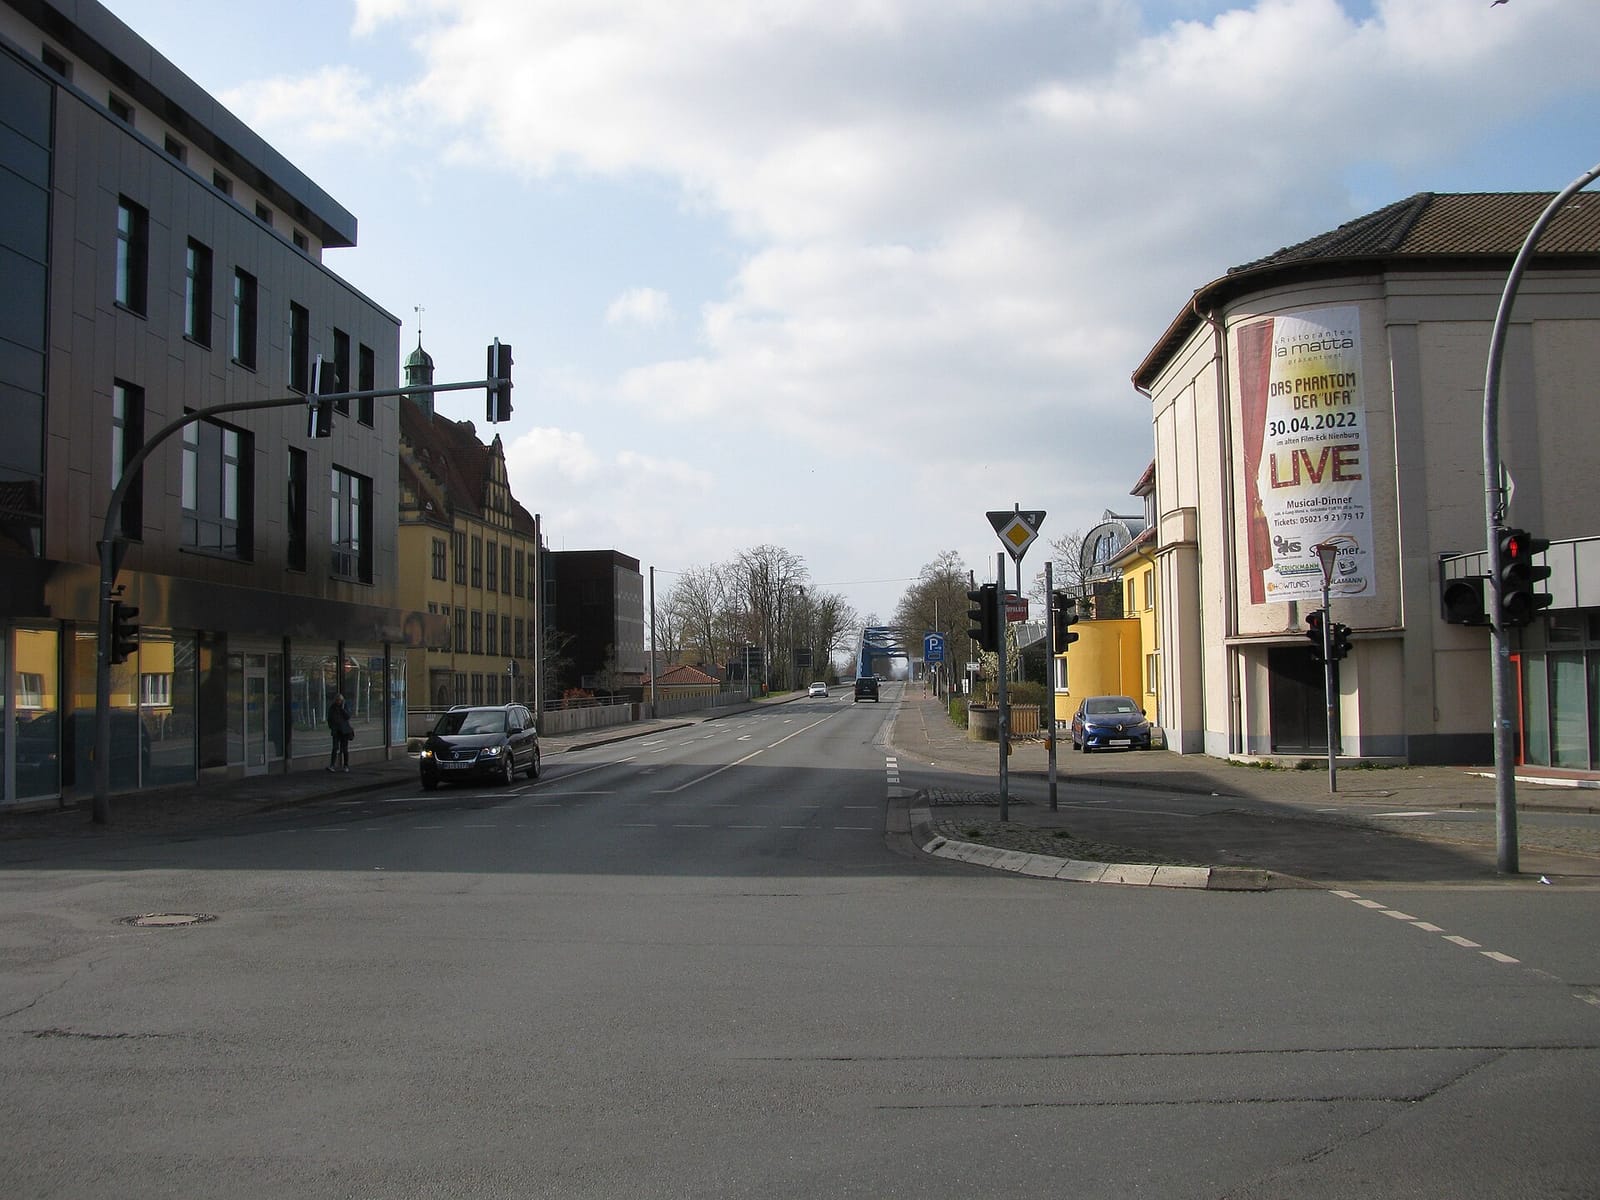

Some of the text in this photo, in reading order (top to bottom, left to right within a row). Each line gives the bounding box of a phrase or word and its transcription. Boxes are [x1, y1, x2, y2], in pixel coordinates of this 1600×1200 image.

[1275, 338, 1353, 358] la matta
[1271, 373, 1356, 397] DAS PHANTOM
[1294, 395, 1318, 410] DER
[1269, 412, 1357, 437] 30.04.2022
[1285, 437, 1299, 445] alten
[1301, 433, 1327, 443] Film-Eck
[1328, 431, 1360, 441] Nienburg
[1269, 444, 1362, 489] LIVE
[1286, 496, 1353, 509] Musical-Dinner
[1274, 518, 1298, 527] Tickets:
[1300, 515, 1321, 524] 05021
[1331, 514, 1340, 522] 21
[1343, 513, 1352, 521] 79
[929, 638, 939, 651] P
